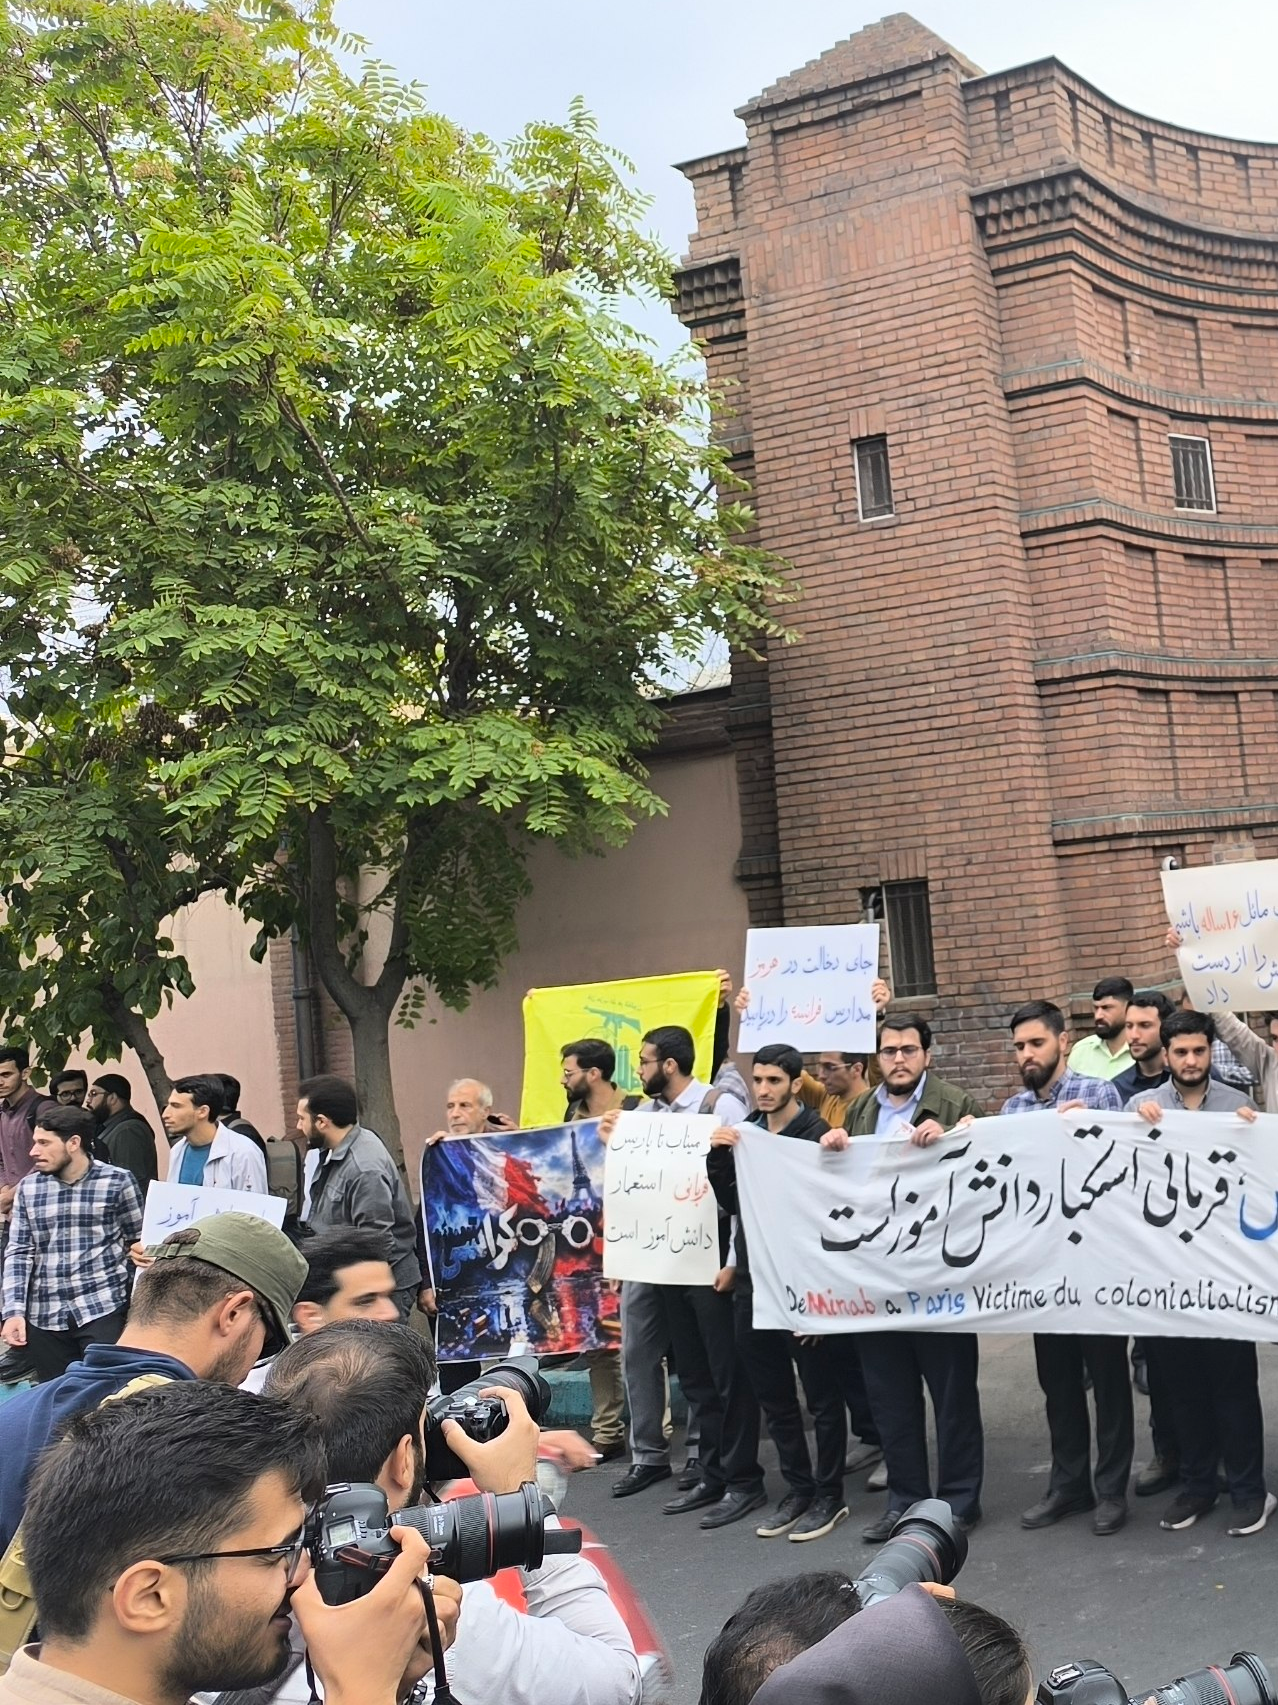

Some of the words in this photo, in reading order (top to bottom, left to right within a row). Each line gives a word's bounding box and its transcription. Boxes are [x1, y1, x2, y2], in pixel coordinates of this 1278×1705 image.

[781, 959, 798, 975] در
[802, 945, 840, 974] دخالت
[845, 943, 874, 975] جای
[1191, 953, 1230, 973] دست
[1231, 945, 1248, 974] از
[1253, 944, 1267, 973] را
[1206, 979, 1230, 1005] داد
[776, 997, 788, 1027] را
[824, 995, 872, 1026] مدارس
[610, 1123, 653, 1155] پاریس
[656, 1123, 665, 1148] تا
[665, 1124, 701, 1155] میناب
[609, 1165, 663, 1196] استعمار
[673, 1171, 710, 1207] قربانی
[1032, 1124, 1138, 1245] استکبار
[1143, 1127, 1238, 1244] قربانی
[820, 1174, 900, 1252] است
[605, 1219, 639, 1243] است
[907, 1288, 966, 1315] Paris
[973, 1279, 1047, 1312] Victime
[1054, 1276, 1081, 1307] du
